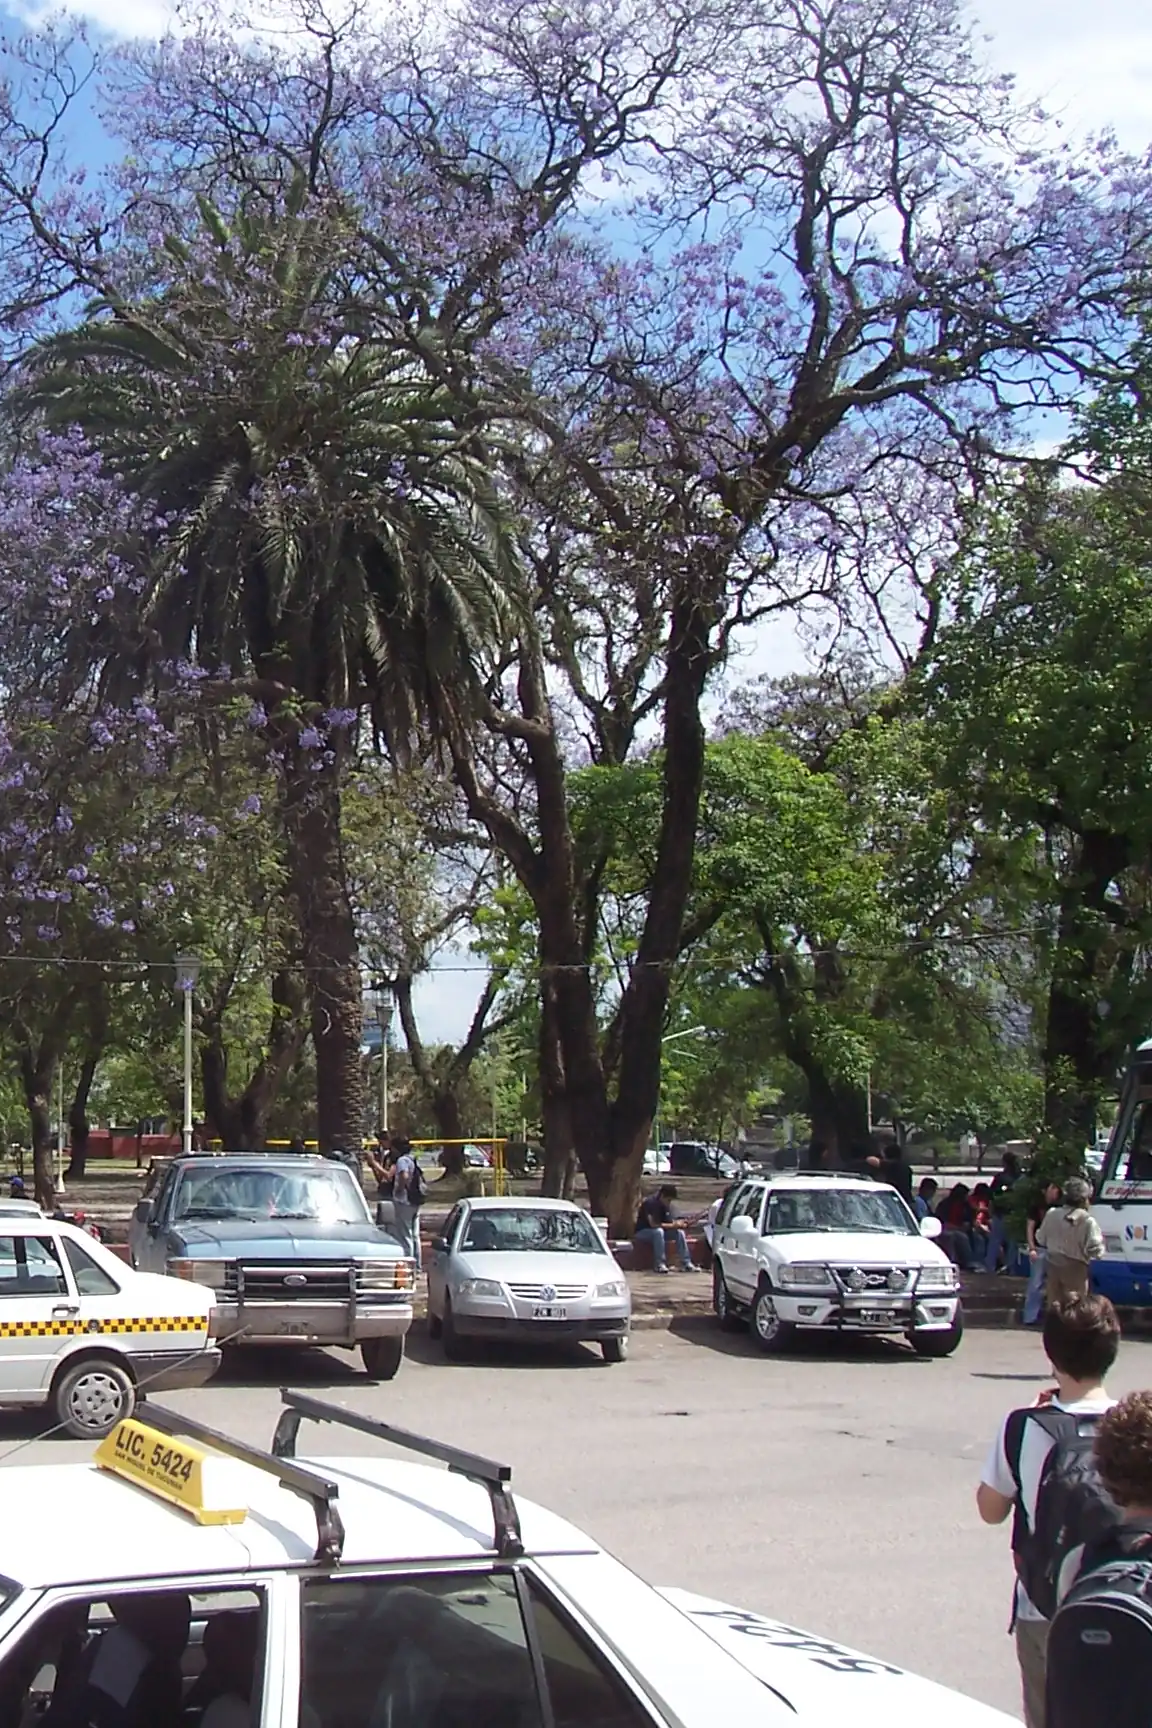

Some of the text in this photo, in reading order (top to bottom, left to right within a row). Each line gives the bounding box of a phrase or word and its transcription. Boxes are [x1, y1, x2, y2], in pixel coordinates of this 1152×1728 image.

[115, 1426, 195, 1482] LIC. 5424
[686, 1610, 905, 1676] 5424
